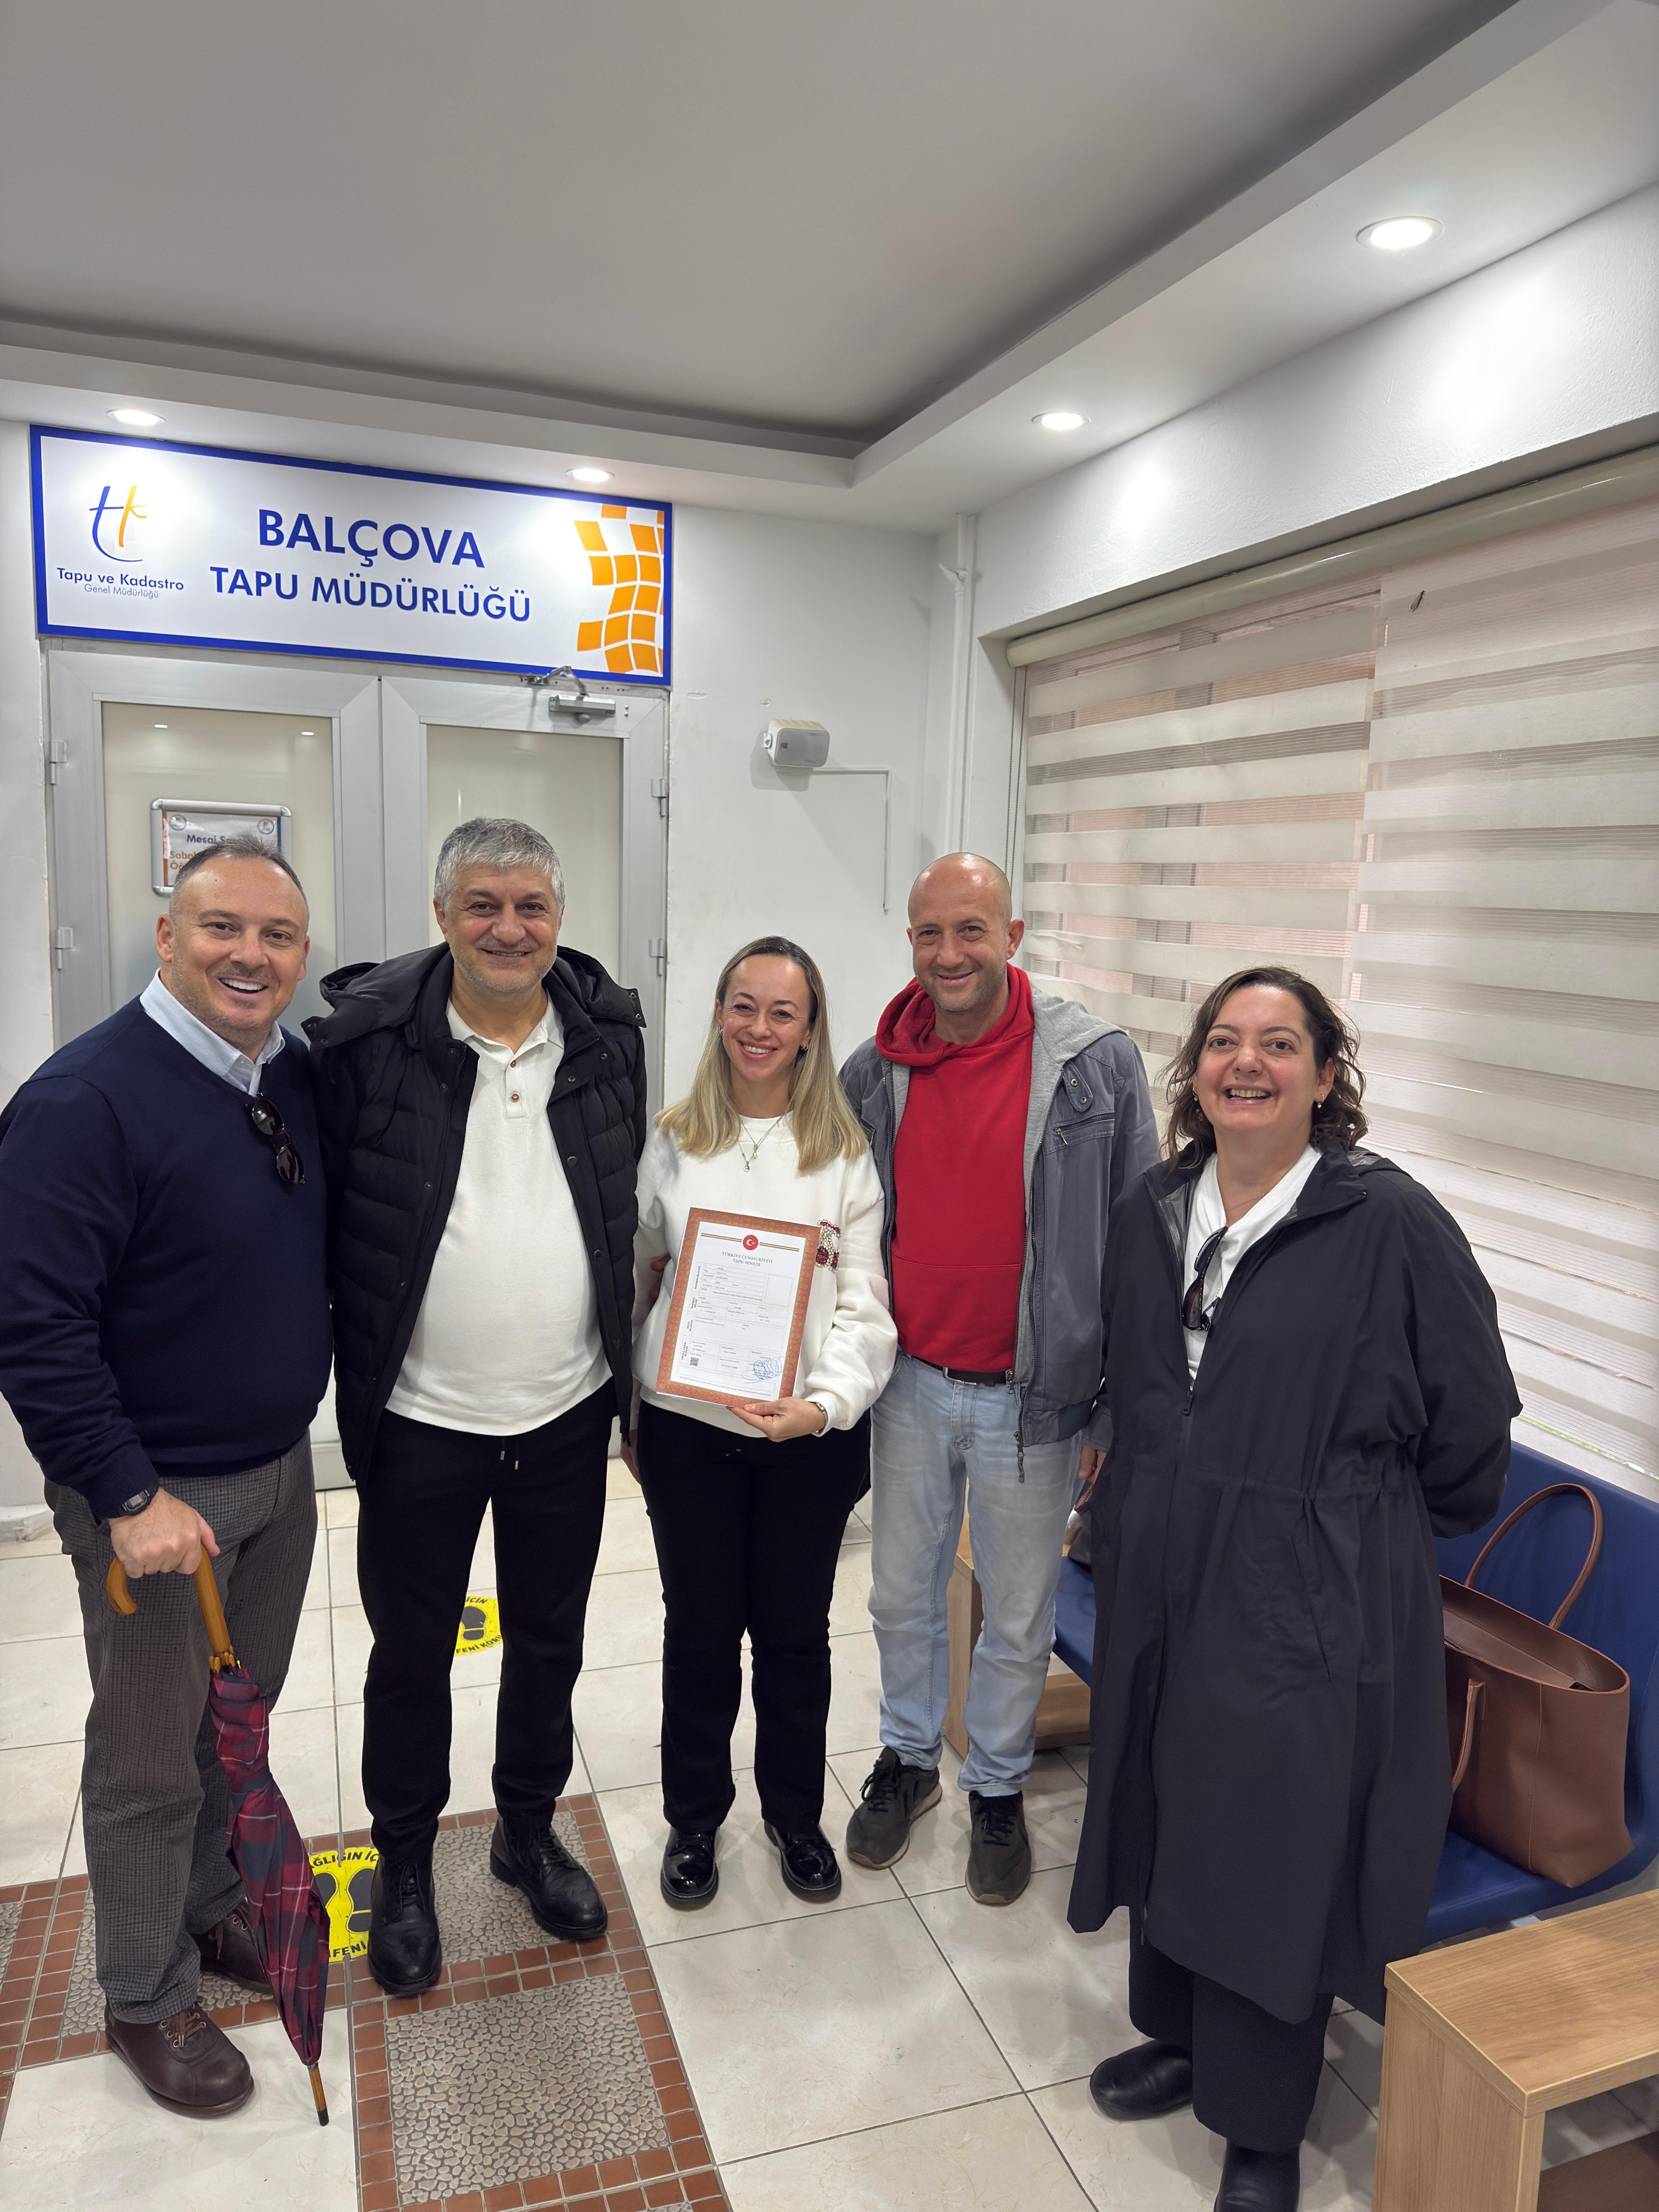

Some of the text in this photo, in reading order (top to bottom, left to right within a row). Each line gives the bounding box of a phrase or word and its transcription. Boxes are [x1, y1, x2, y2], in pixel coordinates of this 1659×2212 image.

[259, 509, 485, 568] BALÇOVA
[57, 567, 184, 591] Tapu ve Kadastro
[84, 584, 159, 599] Genel Müdürlüğü
[210, 566, 530, 622] TAPU MÜDÜRLÜĞÜ
[187, 834, 216, 844] Mesai
